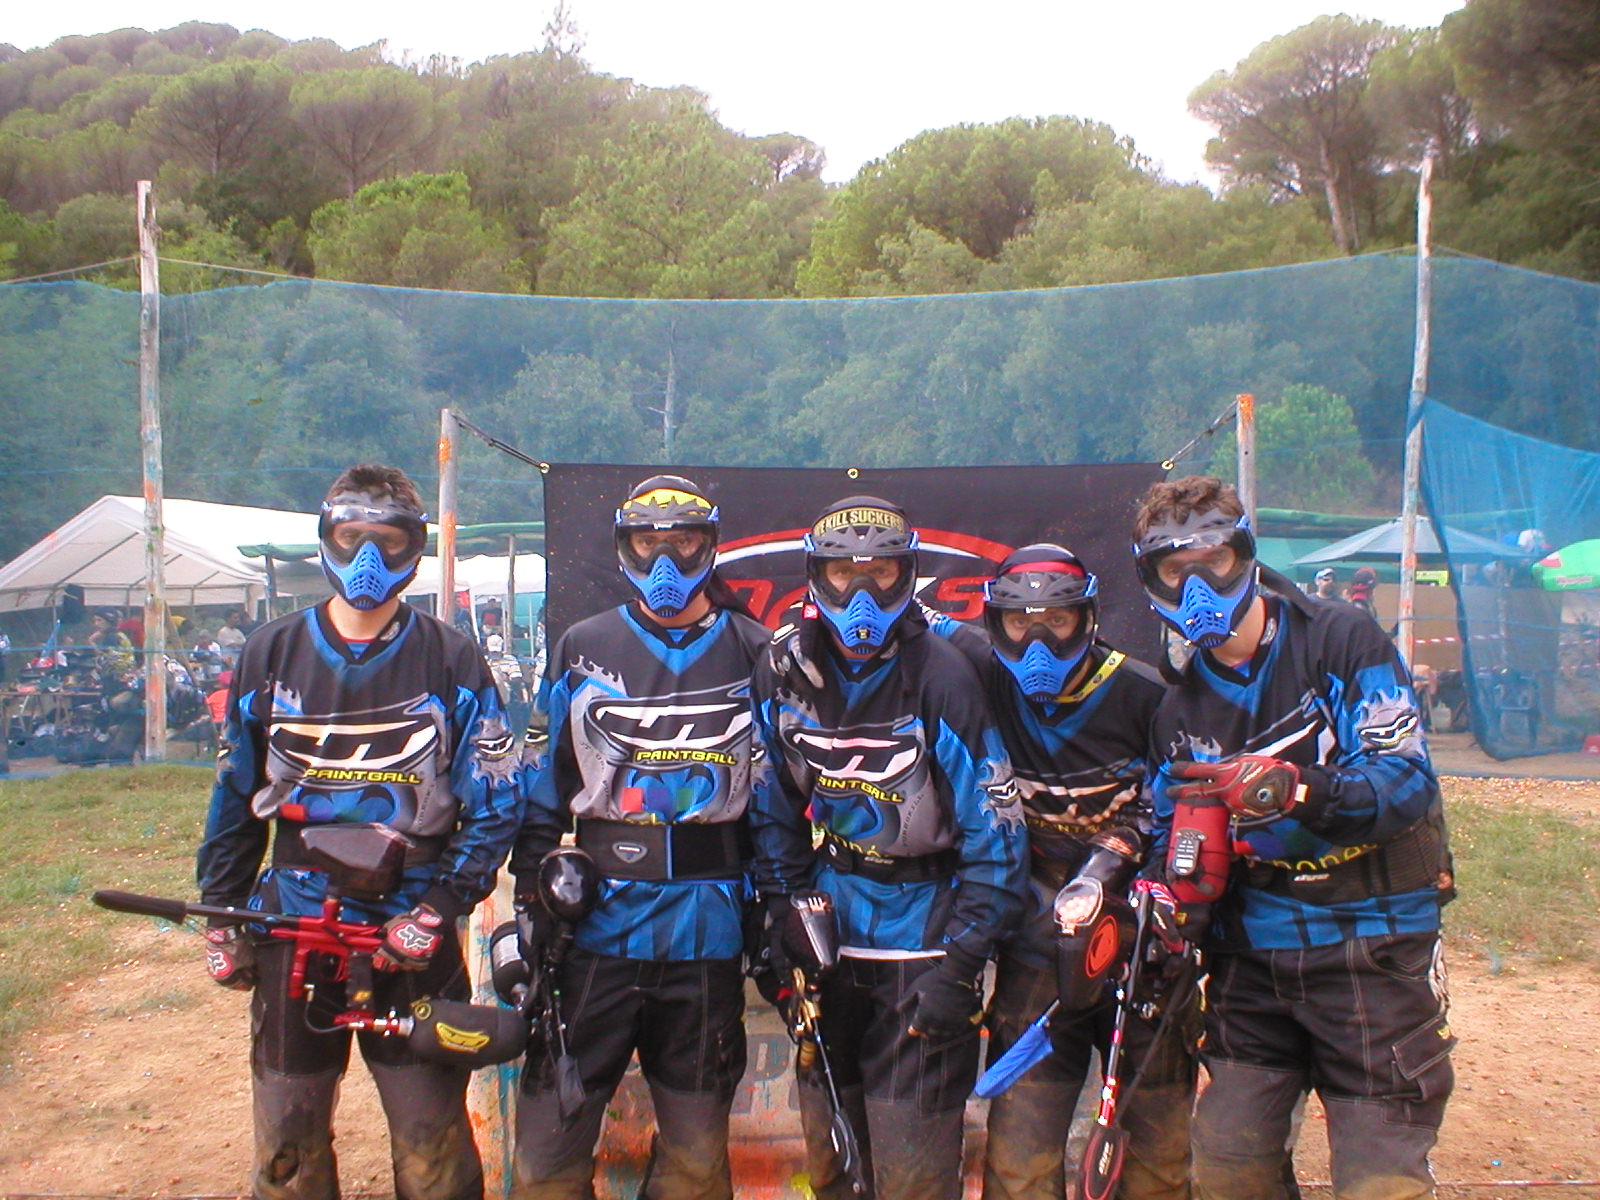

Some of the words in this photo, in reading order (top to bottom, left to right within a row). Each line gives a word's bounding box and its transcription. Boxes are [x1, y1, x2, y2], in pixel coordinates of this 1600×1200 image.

[825, 512, 849, 531] KILL
[635, 750, 738, 766] PAINTBALL
[303, 768, 422, 785] PAINTBALL
[818, 776, 904, 803] AINTBALL
